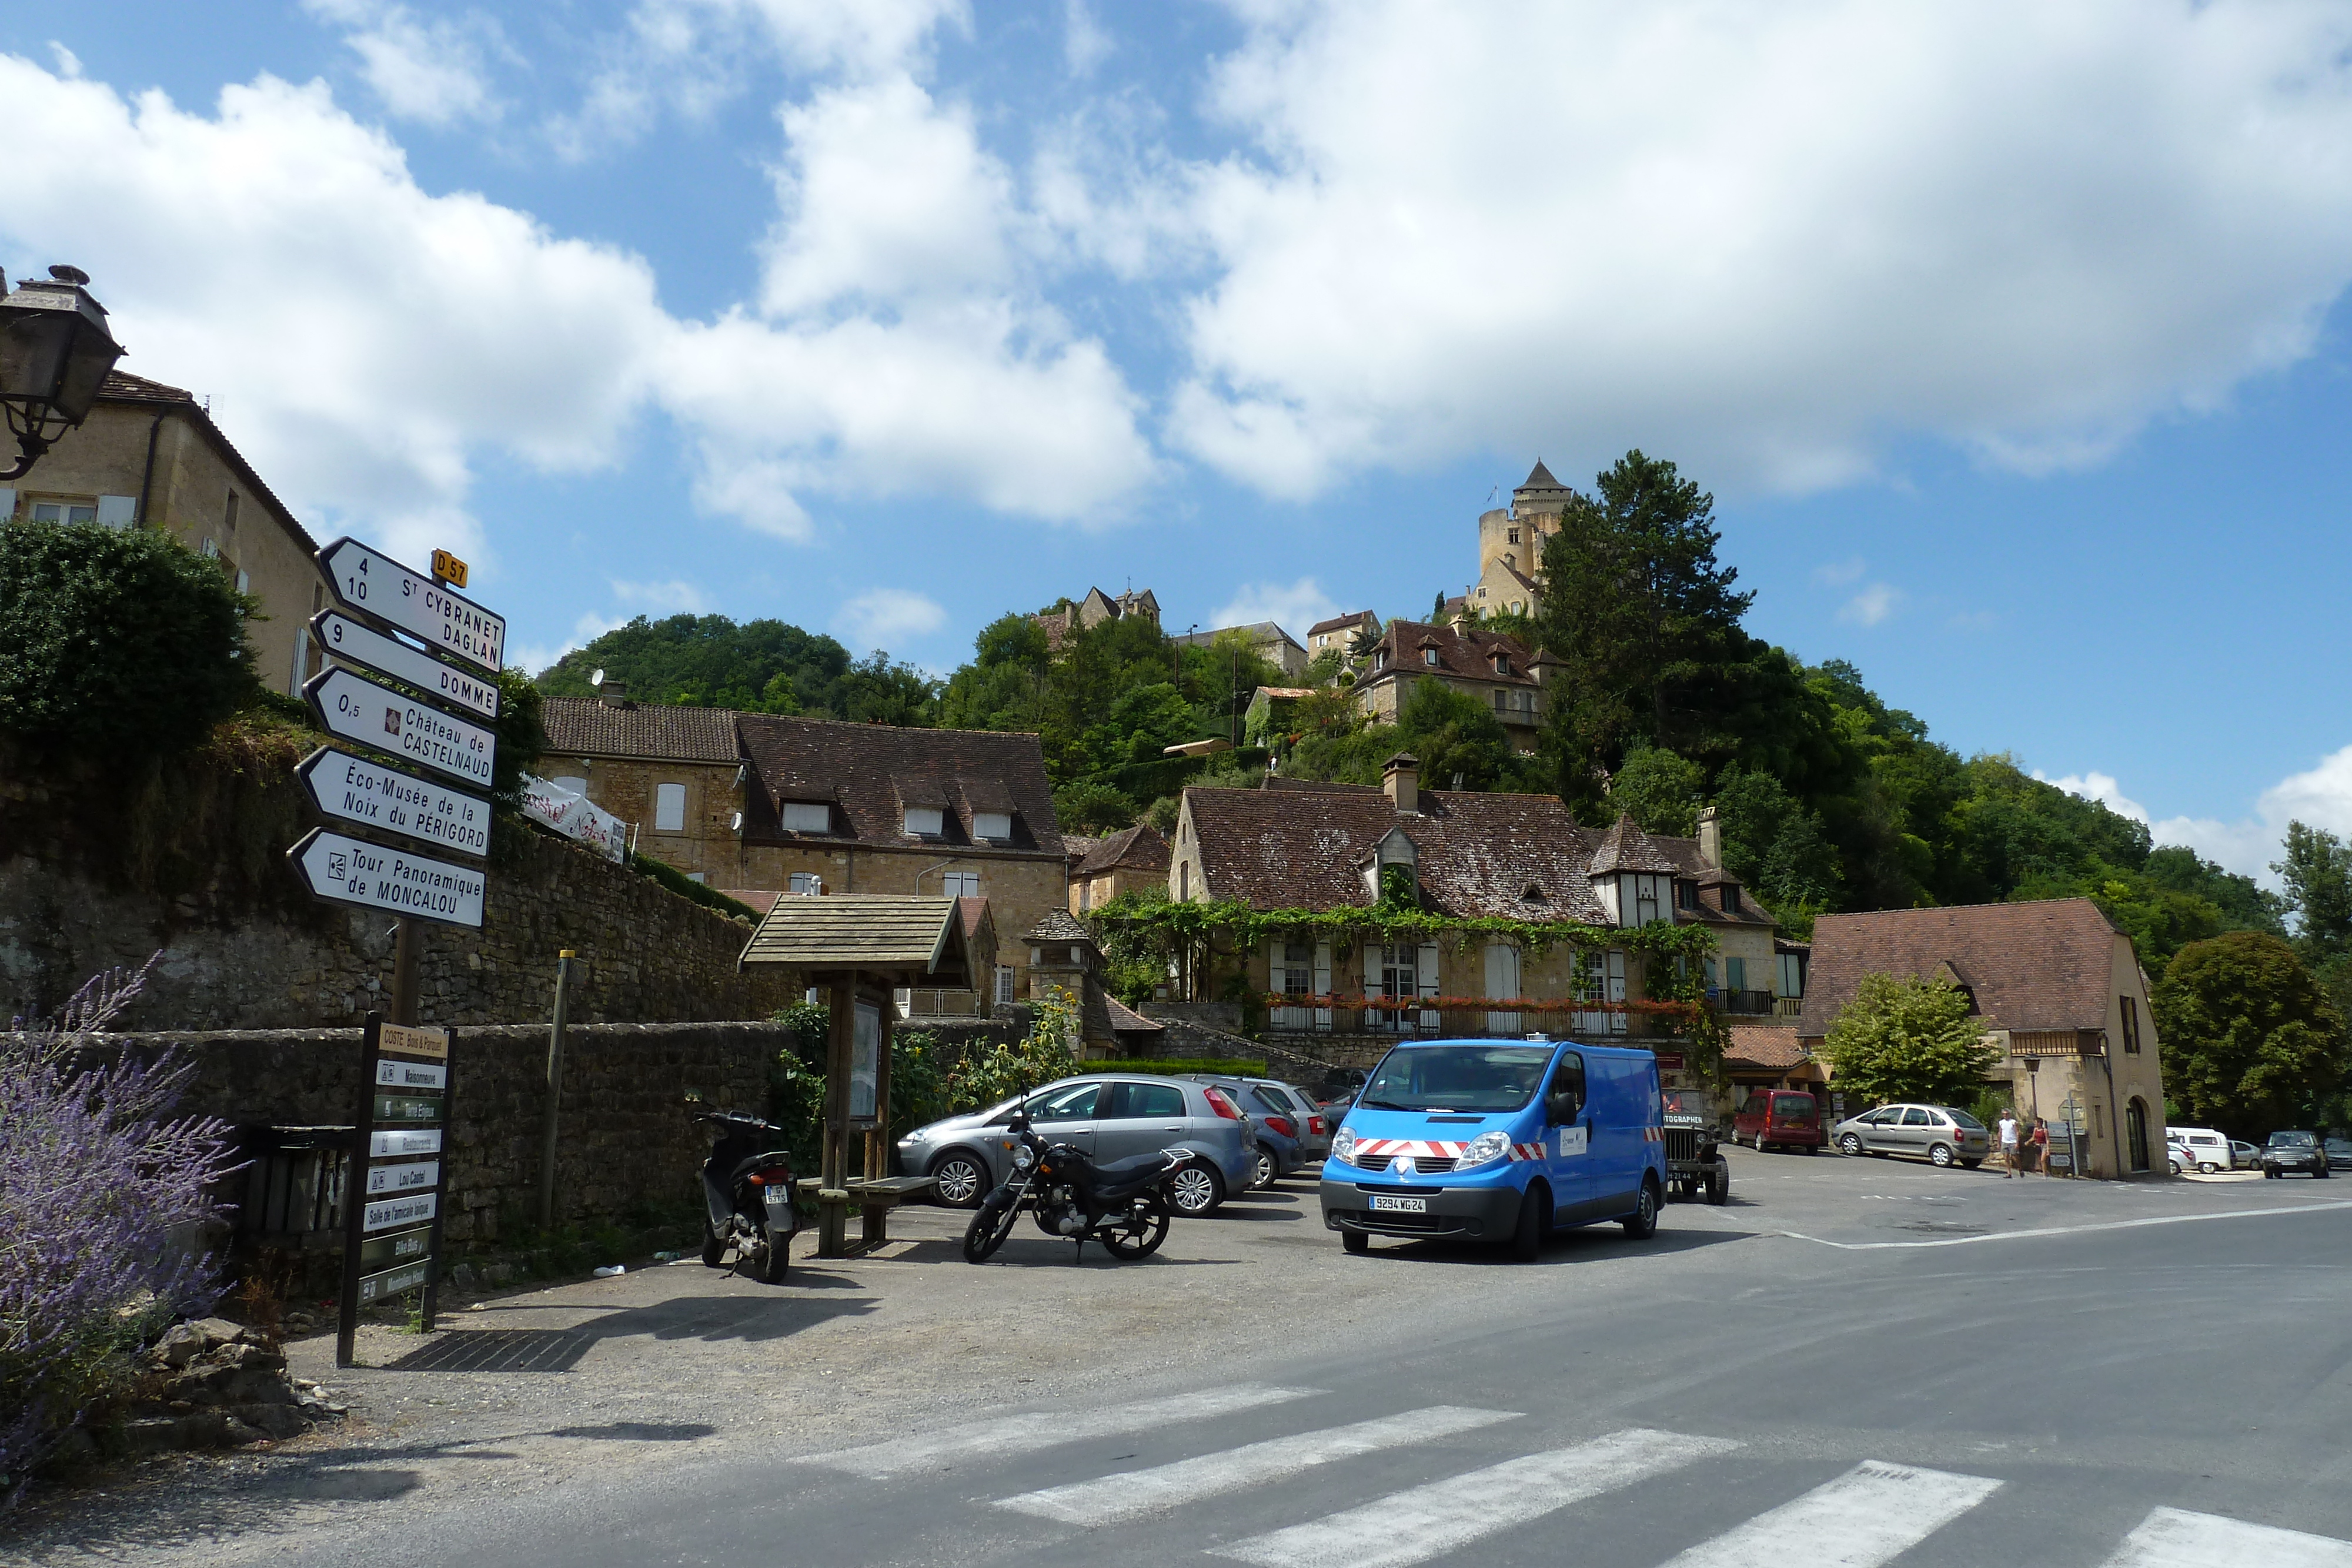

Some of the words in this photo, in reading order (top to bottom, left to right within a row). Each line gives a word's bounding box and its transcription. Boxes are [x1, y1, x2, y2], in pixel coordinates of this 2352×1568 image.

[359, 558, 368, 576] 4
[437, 554, 445, 571] D
[450, 561, 465, 581] 57
[349, 577, 367, 600] 10
[426, 591, 499, 641] CYBRANET
[333, 624, 342, 643] 9
[444, 624, 497, 664] DAGLAN
[440, 671, 493, 710] DOMME
[338, 694, 360, 717] 0,5
[406, 708, 460, 744] Château
[470, 735, 484, 753] de
[404, 733, 489, 778] CASTELNAUD
[346, 762, 428, 808] Éco-Musée
[439, 797, 453, 813] de
[463, 803, 473, 821] la
[343, 792, 379, 818] Noix
[390, 807, 406, 825] du
[416, 812, 484, 848] PÉRIGORD
[352, 848, 384, 872] Tour
[393, 859, 480, 897] Panoramique
[348, 875, 366, 895] de
[377, 881, 457, 914] MONCALOU
[385, 1029, 404, 1046] COSTE
[1663, 1115, 1702, 1124] TOGRAPHER
[399, 1172, 409, 1186] Lou
[369, 1209, 383, 1225] Salle
[384, 1207, 390, 1222] de
[1377, 1198, 1398, 1209] 9294
[1400, 1199, 1411, 1210] WG
[1412, 1201, 1422, 1211] 24
